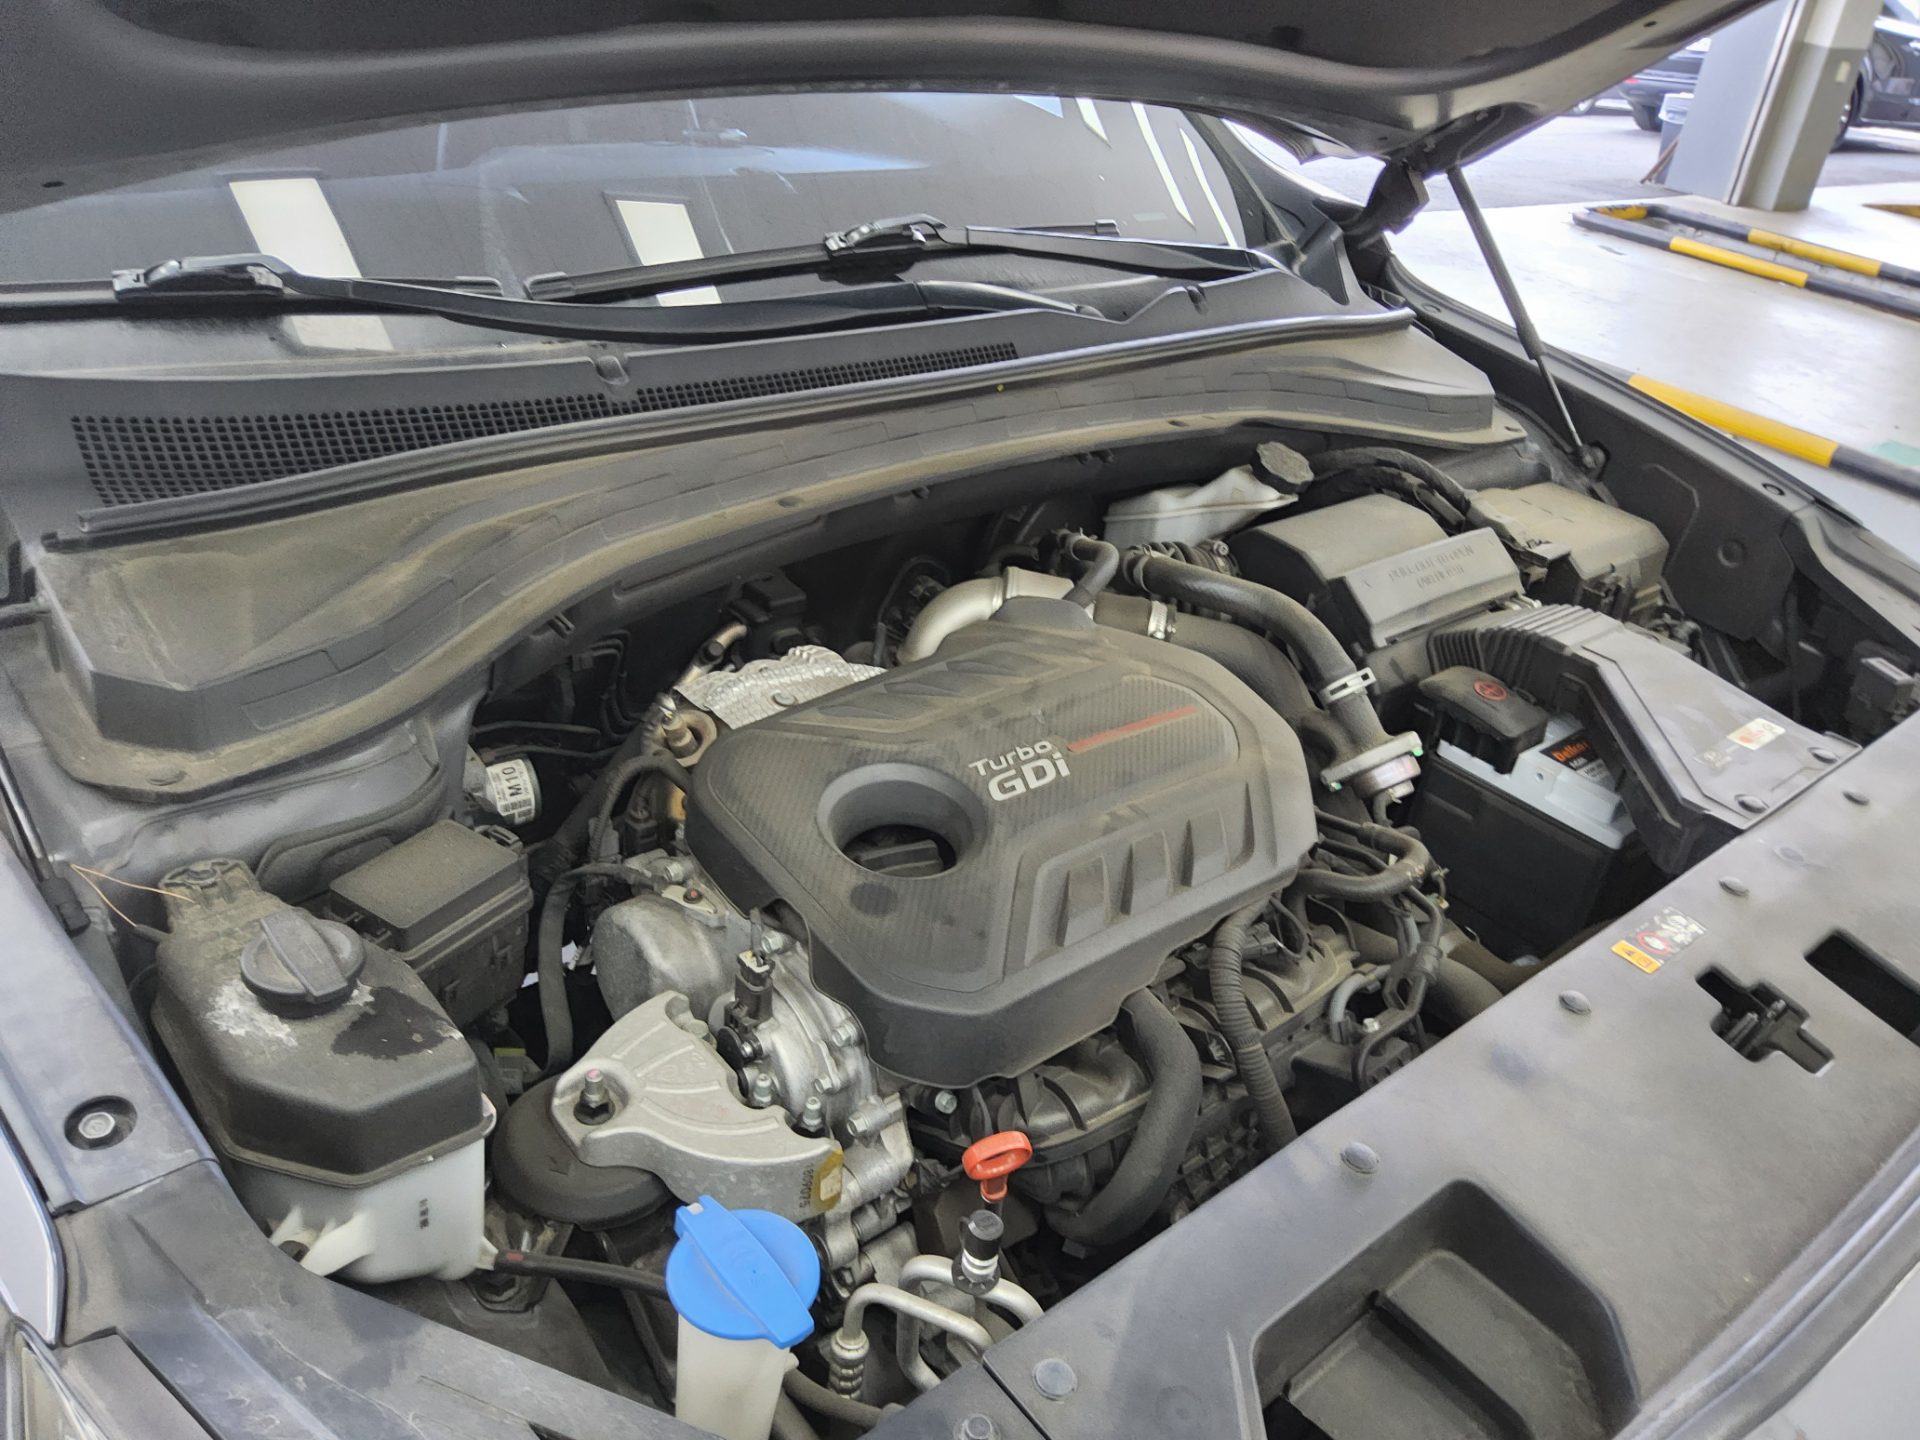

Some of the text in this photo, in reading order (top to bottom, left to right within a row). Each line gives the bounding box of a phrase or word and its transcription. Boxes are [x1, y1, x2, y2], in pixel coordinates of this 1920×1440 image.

[968, 740, 1053, 776] Turbo
[987, 751, 1071, 801] GDi
[502, 766, 523, 797] M10
